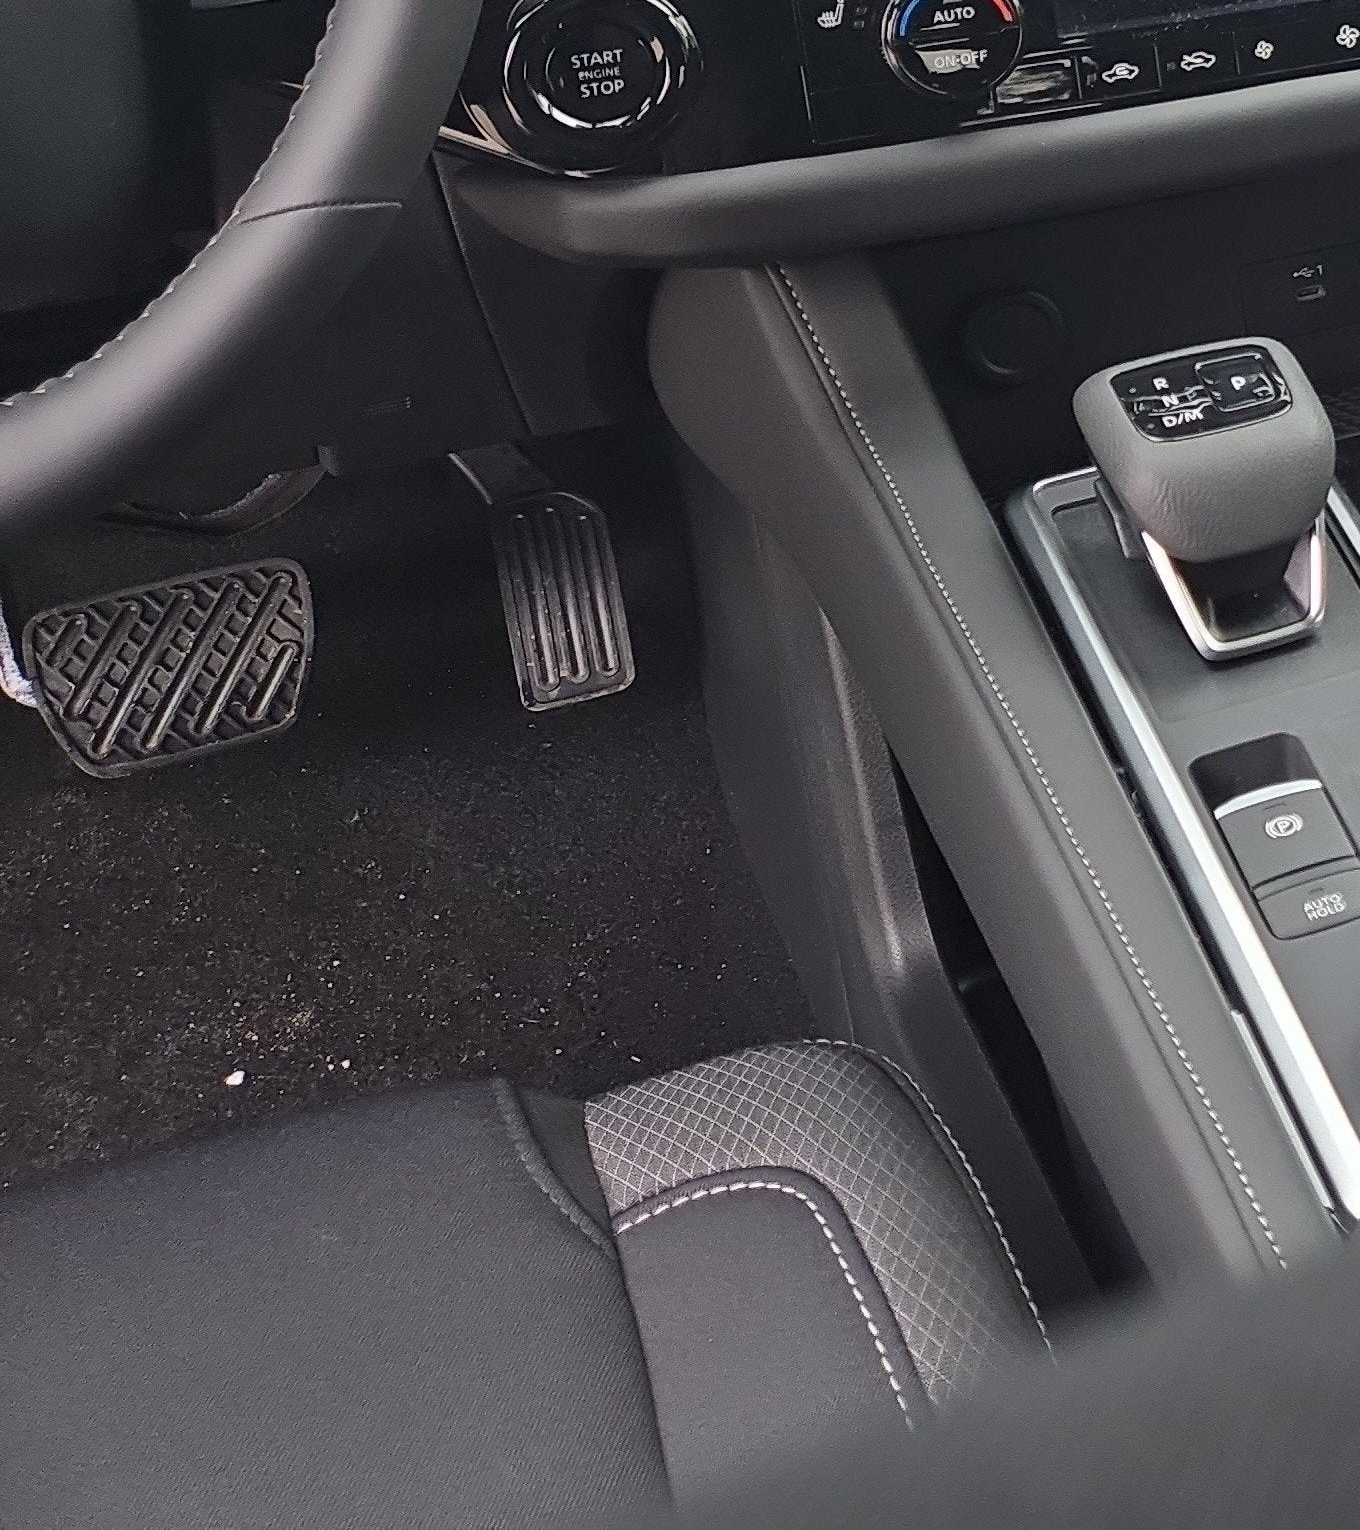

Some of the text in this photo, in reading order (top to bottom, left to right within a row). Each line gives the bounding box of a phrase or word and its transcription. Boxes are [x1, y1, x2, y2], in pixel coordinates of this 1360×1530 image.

[933, 6, 976, 24] AUTO
[570, 49, 623, 69] START
[578, 66, 621, 81] ENGINE
[580, 79, 625, 99] STOP
[1316, 264, 1323, 275] 1
[1152, 377, 1169, 390] R
[1230, 376, 1247, 390] P
[1161, 394, 1180, 408] N
[1162, 409, 1205, 428] D/M
[1303, 893, 1343, 913] AUTO
[1306, 903, 1346, 921] HOLD
